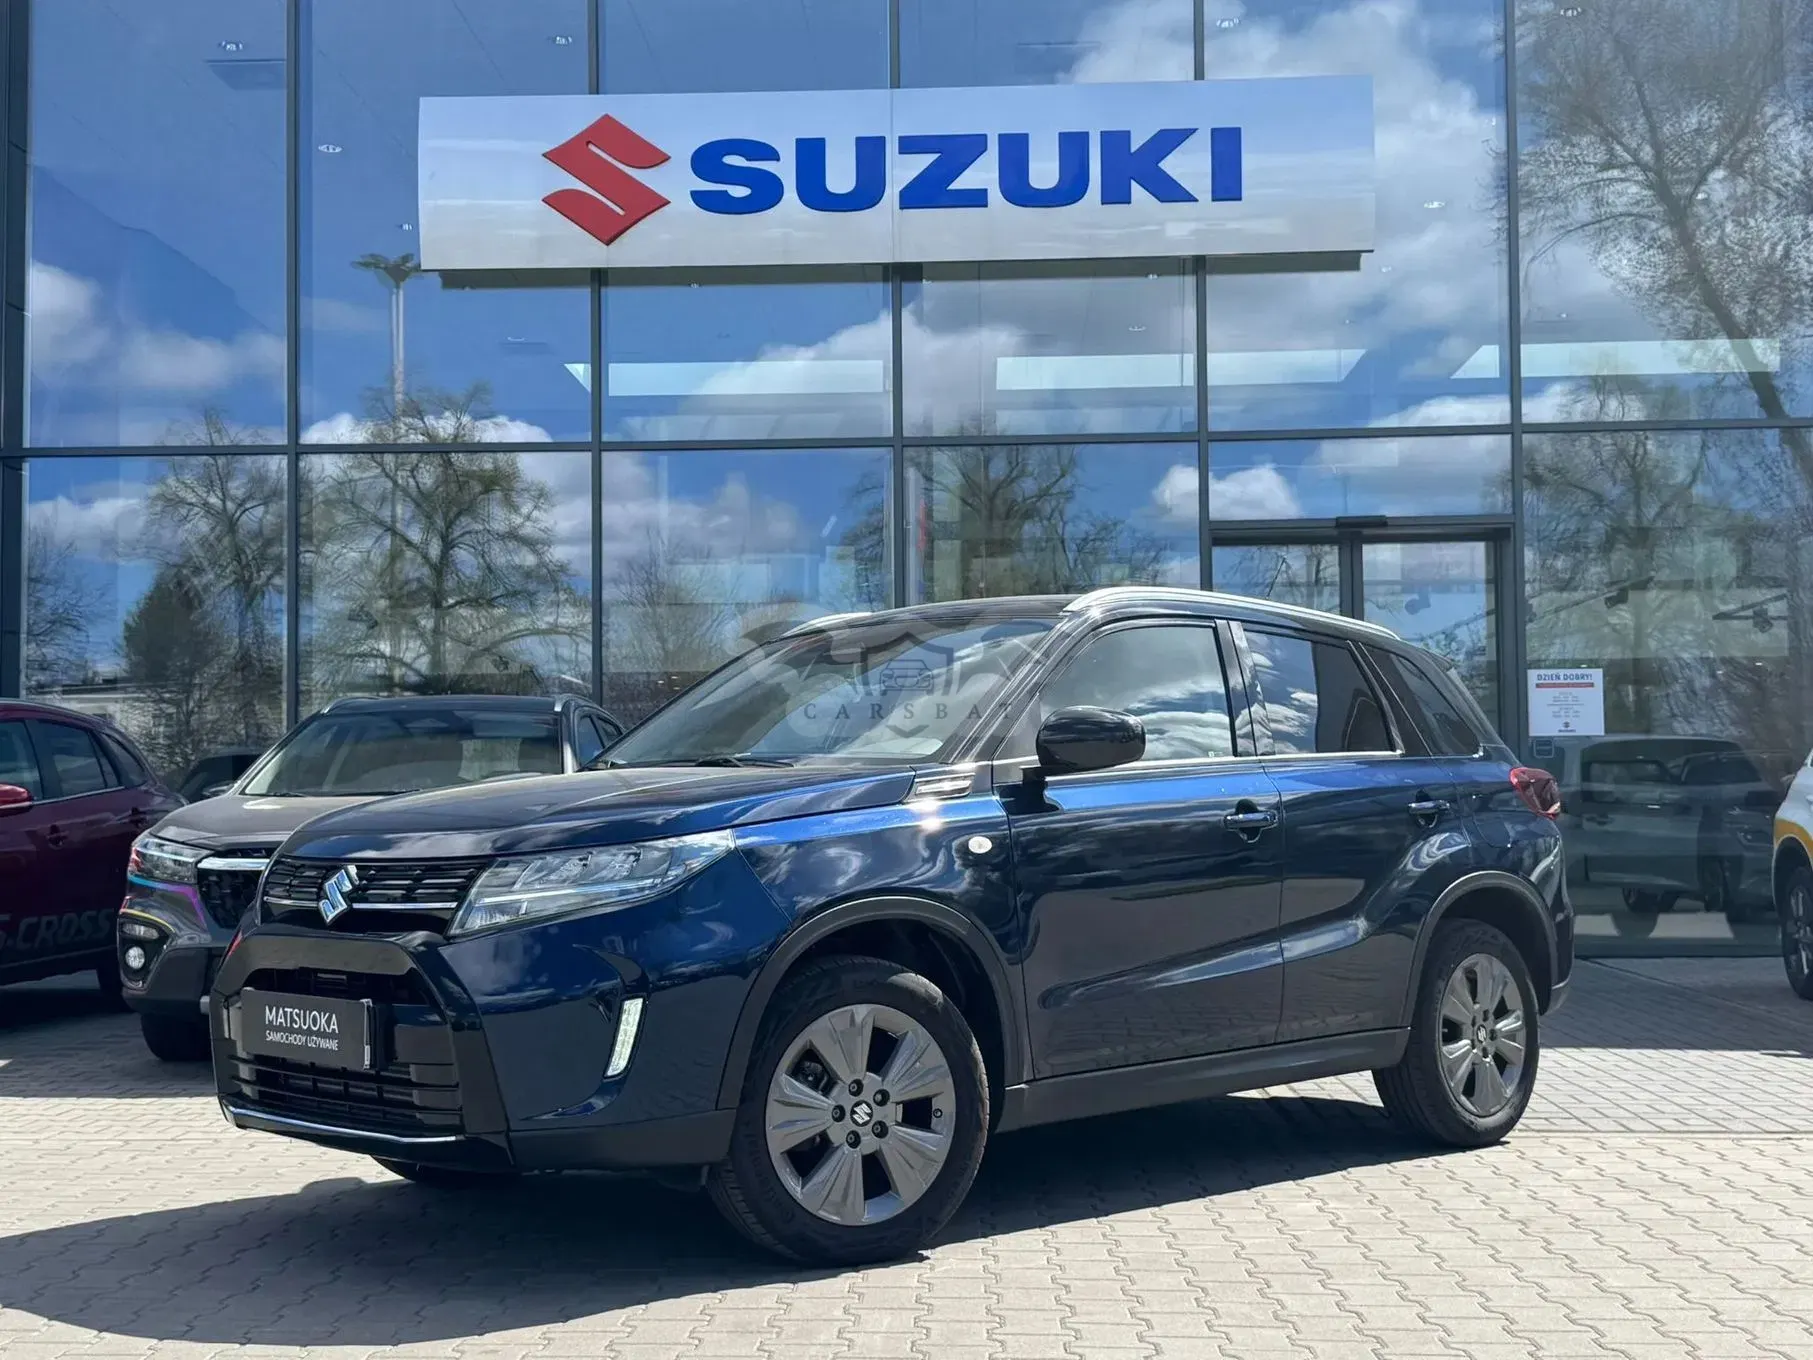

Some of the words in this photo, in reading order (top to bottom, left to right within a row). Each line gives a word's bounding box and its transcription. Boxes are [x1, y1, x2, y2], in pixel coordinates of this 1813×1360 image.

[690, 127, 1242, 215] SUZUKI
[1562, 672, 1593, 681] DOBRY!
[265, 1005, 339, 1034] MATSUOKA
[266, 1030, 306, 1045] SAMOCHODY
[307, 1036, 339, 1051] UŻYWANE
